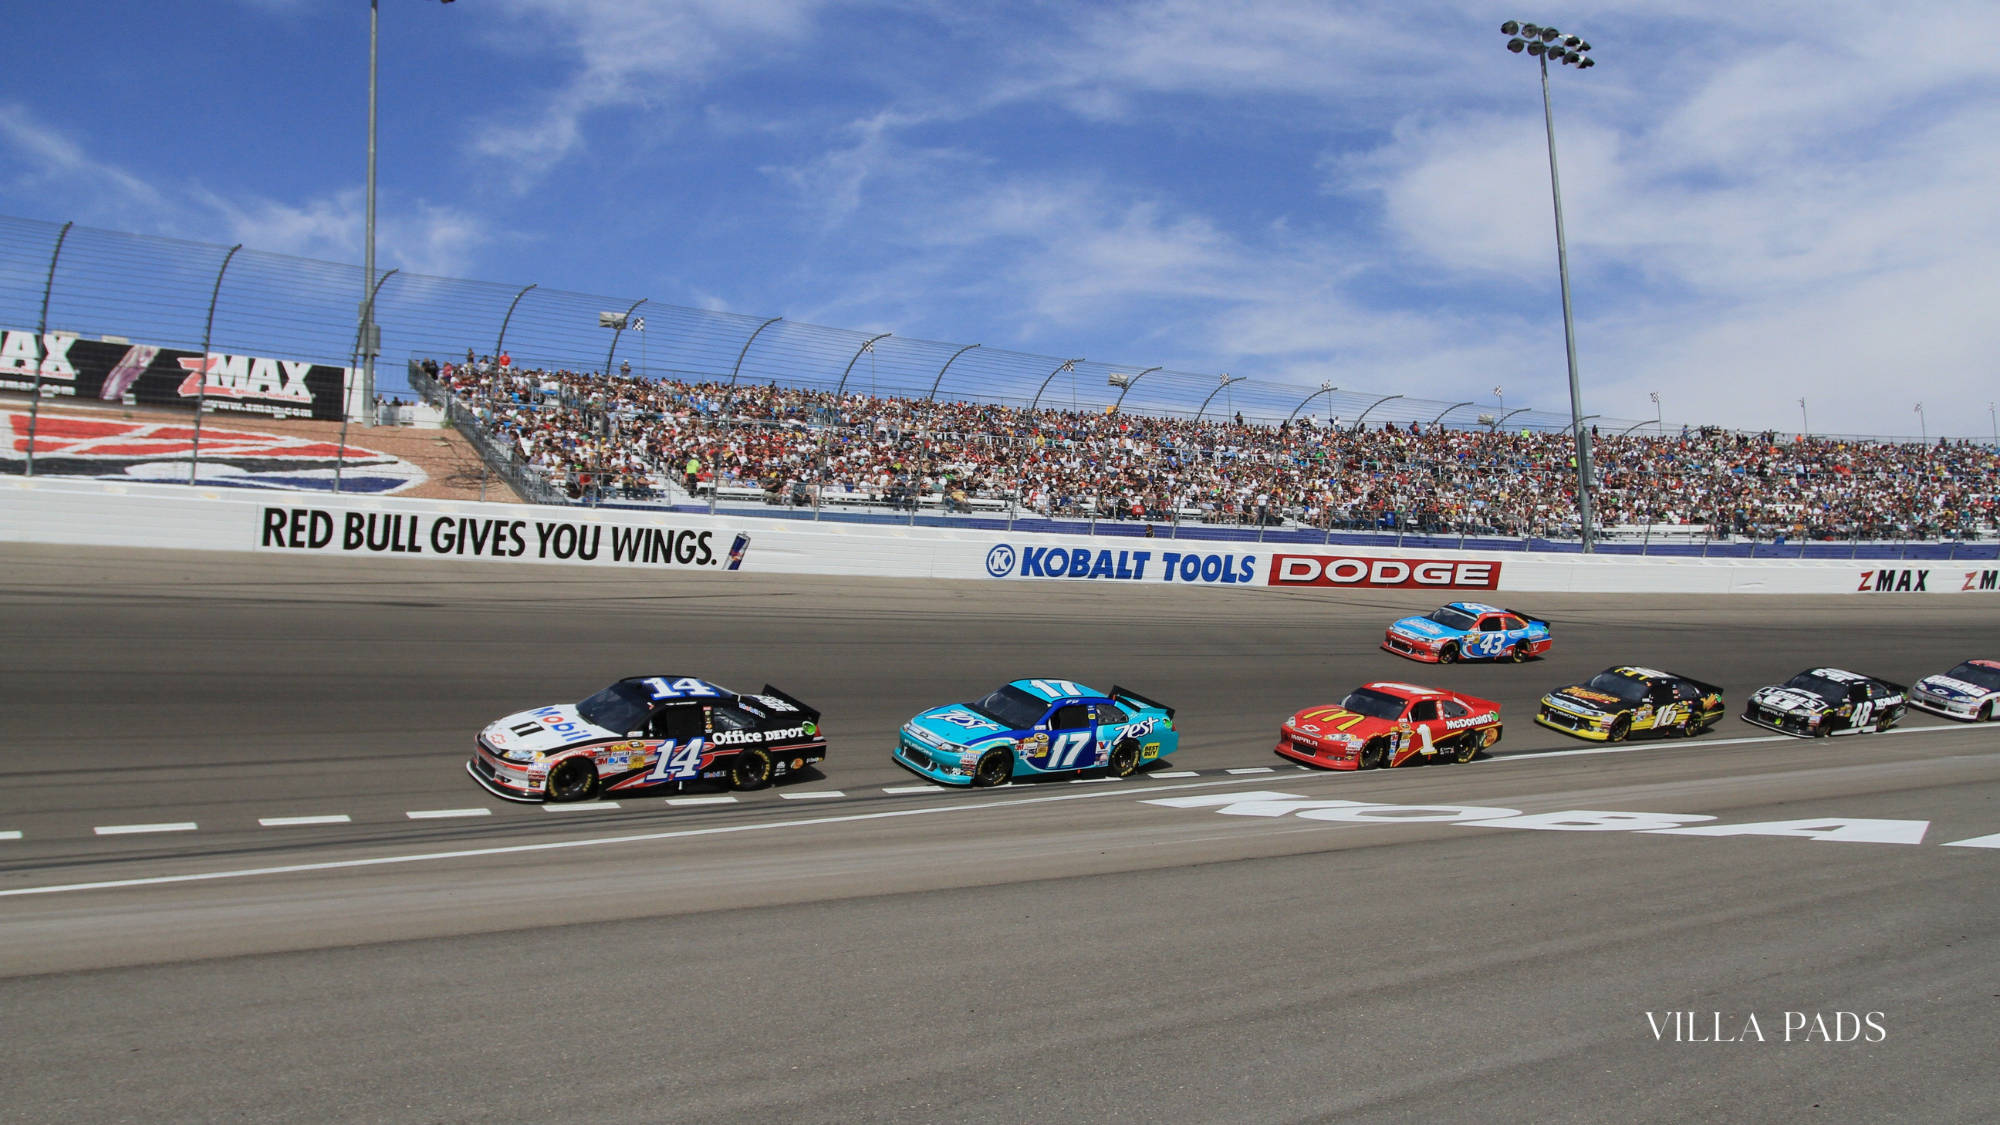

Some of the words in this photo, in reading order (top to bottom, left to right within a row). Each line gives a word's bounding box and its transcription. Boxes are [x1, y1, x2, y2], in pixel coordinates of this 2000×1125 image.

[0, 331, 77, 380] AX
[262, 507, 334, 549] RED
[342, 511, 422, 553] BULL
[430, 516, 527, 557] GIVES
[535, 522, 602, 561] YOU
[611, 526, 717, 566] WINGS.
[1020, 546, 1150, 579] KOBALT
[1162, 552, 1256, 583] TOOLS
[1278, 557, 1491, 586] DODGE
[1961, 569, 2000, 592] ZM
[1479, 633, 1506, 655] 43
[642, 676, 719, 700] 14
[527, 706, 593, 742] Mobil
[1445, 713, 1493, 730] McDonald's
[1549, 707, 1579, 721] FUSION
[1650, 702, 1678, 731] 16
[1848, 701, 1874, 728] 48
[711, 730, 762, 745] Office
[763, 727, 804, 741] DEPOT
[904, 738, 933, 757] FUSION
[1291, 734, 1319, 747] IMPALA
[1416, 723, 1438, 756] 1
[645, 737, 706, 783] 14
[1047, 732, 1091, 769] 17
